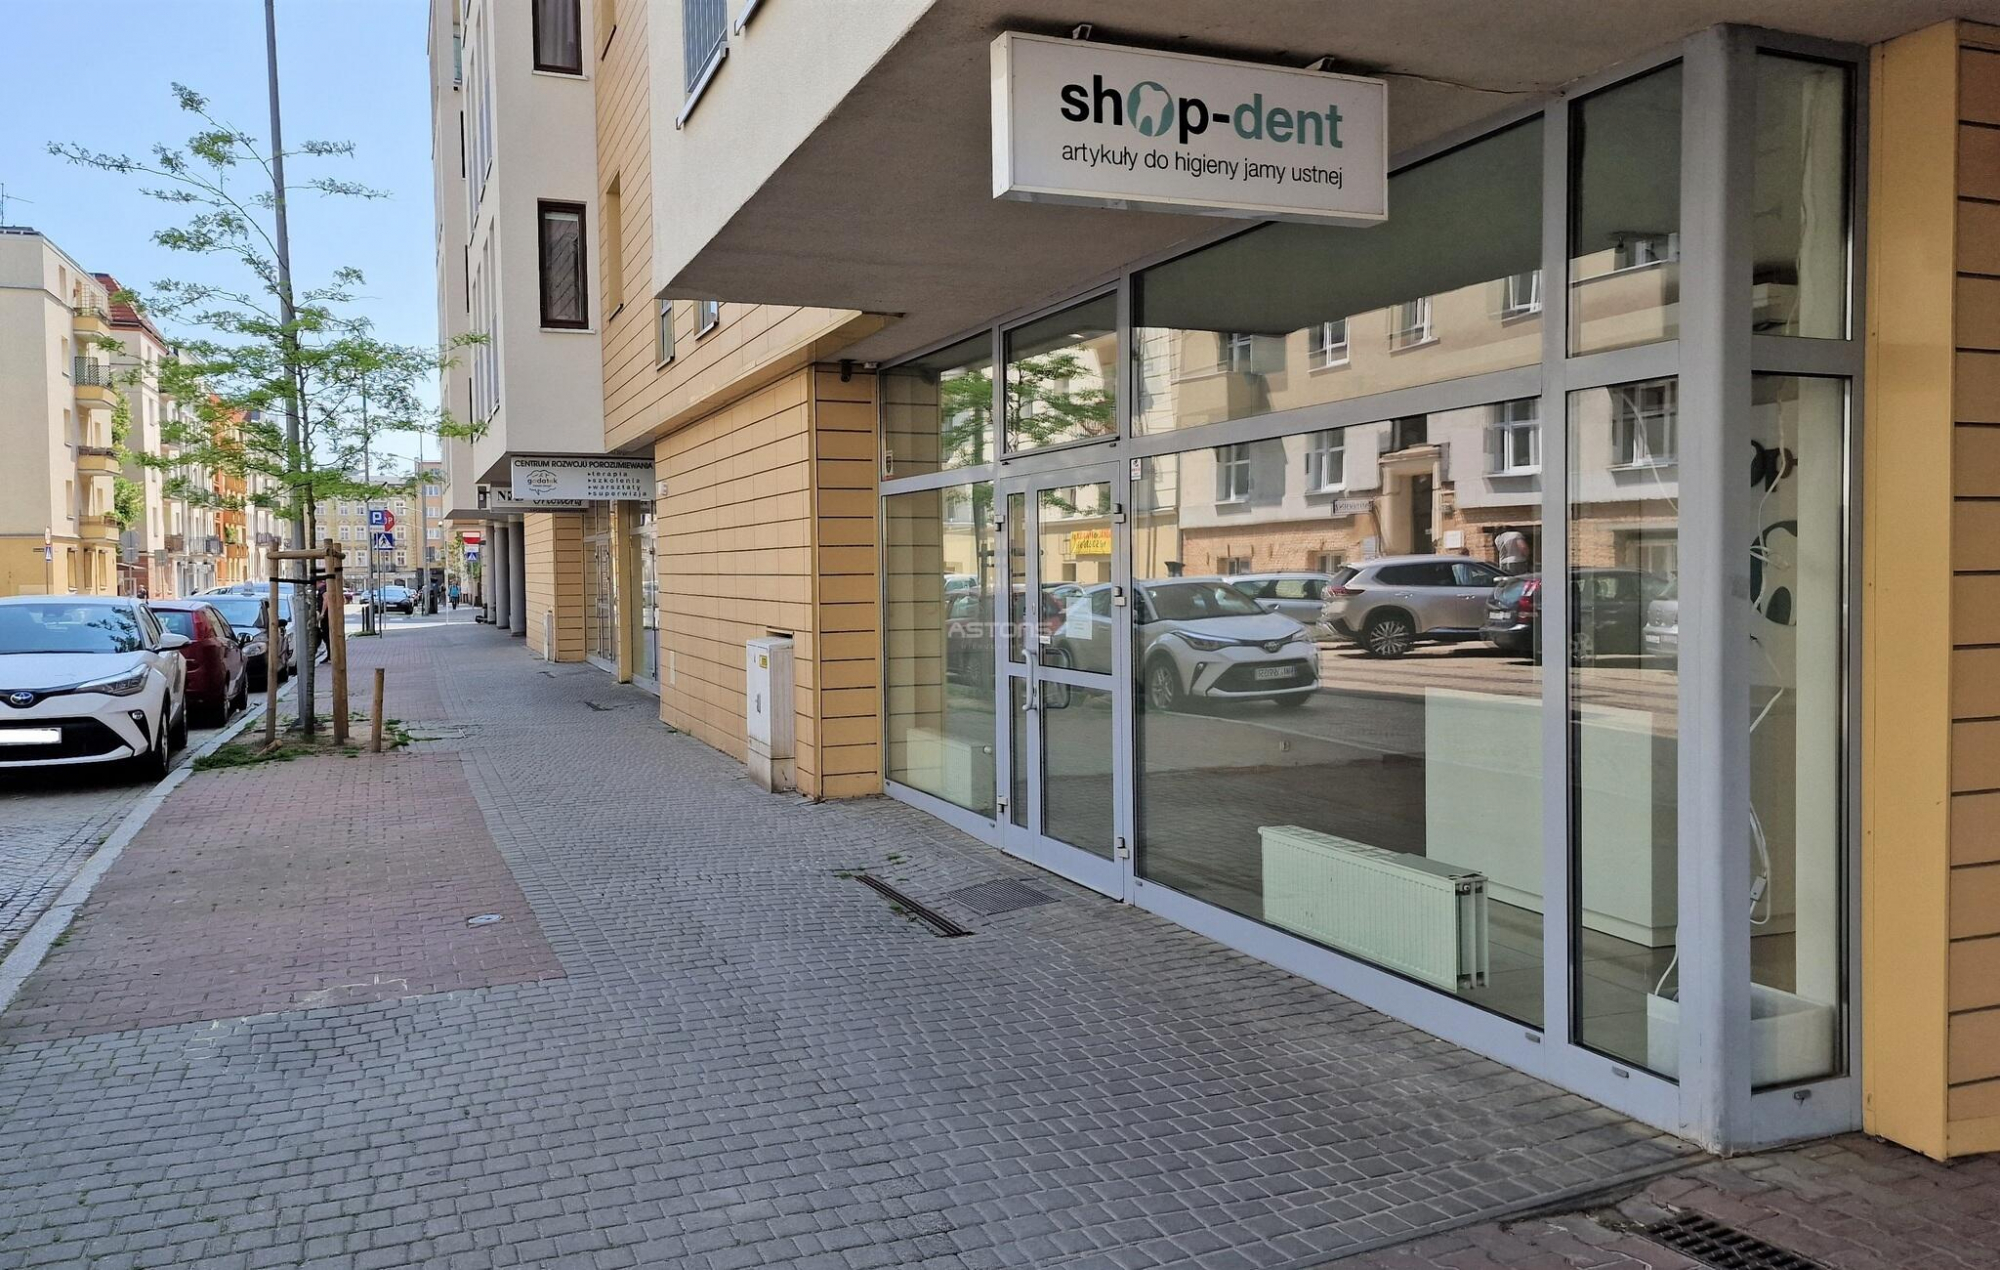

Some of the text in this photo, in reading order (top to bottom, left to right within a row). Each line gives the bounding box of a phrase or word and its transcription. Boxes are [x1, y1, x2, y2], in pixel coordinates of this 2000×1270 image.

[1060, 74, 1343, 149] shop-dent
[1062, 143, 1343, 190] artykuły do higieny jamy ustnej
[514, 460, 654, 469] CENTRUM ROZWOJU POROZUMIEWANIA
[592, 490, 647, 498] superwizja
[372, 511, 382, 524] P
